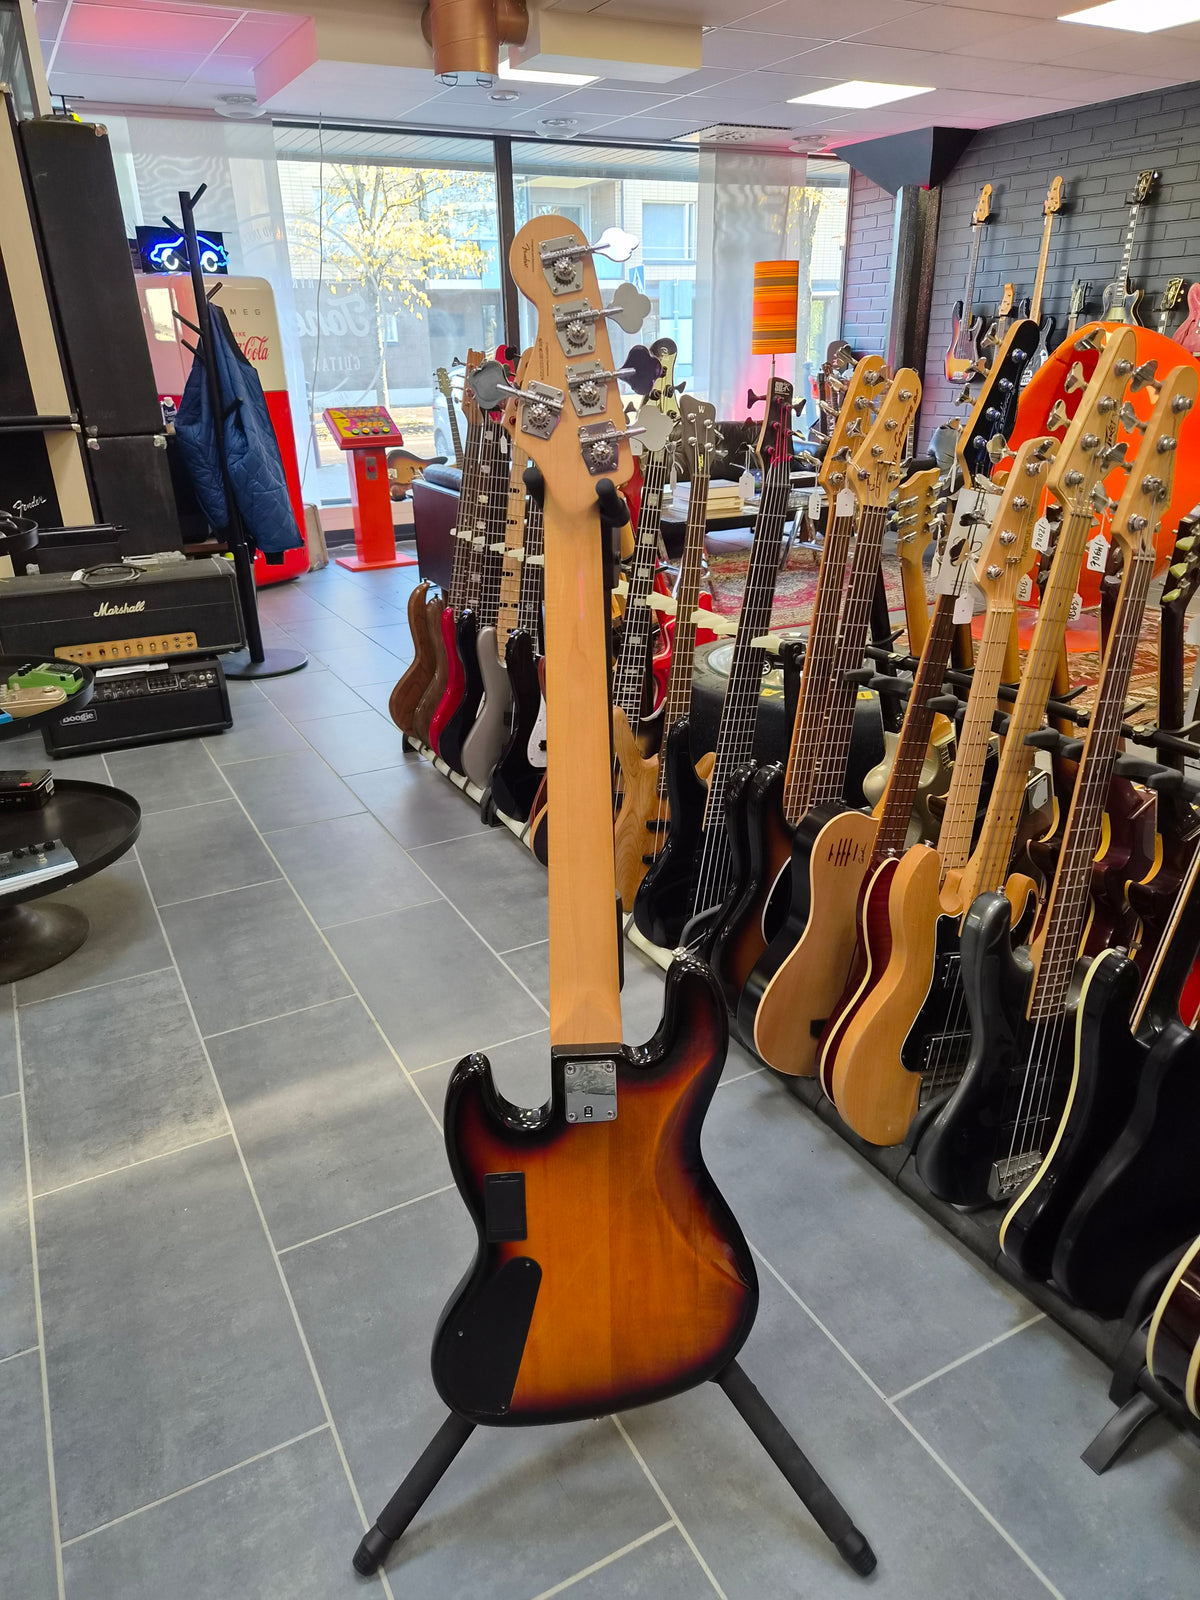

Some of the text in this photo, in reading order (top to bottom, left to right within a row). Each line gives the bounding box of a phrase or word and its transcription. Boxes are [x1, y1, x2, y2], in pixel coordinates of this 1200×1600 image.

[229, 308, 261, 316] MEG
[12, 495, 47, 519] Fender
[93, 599, 146, 618] Marshall
